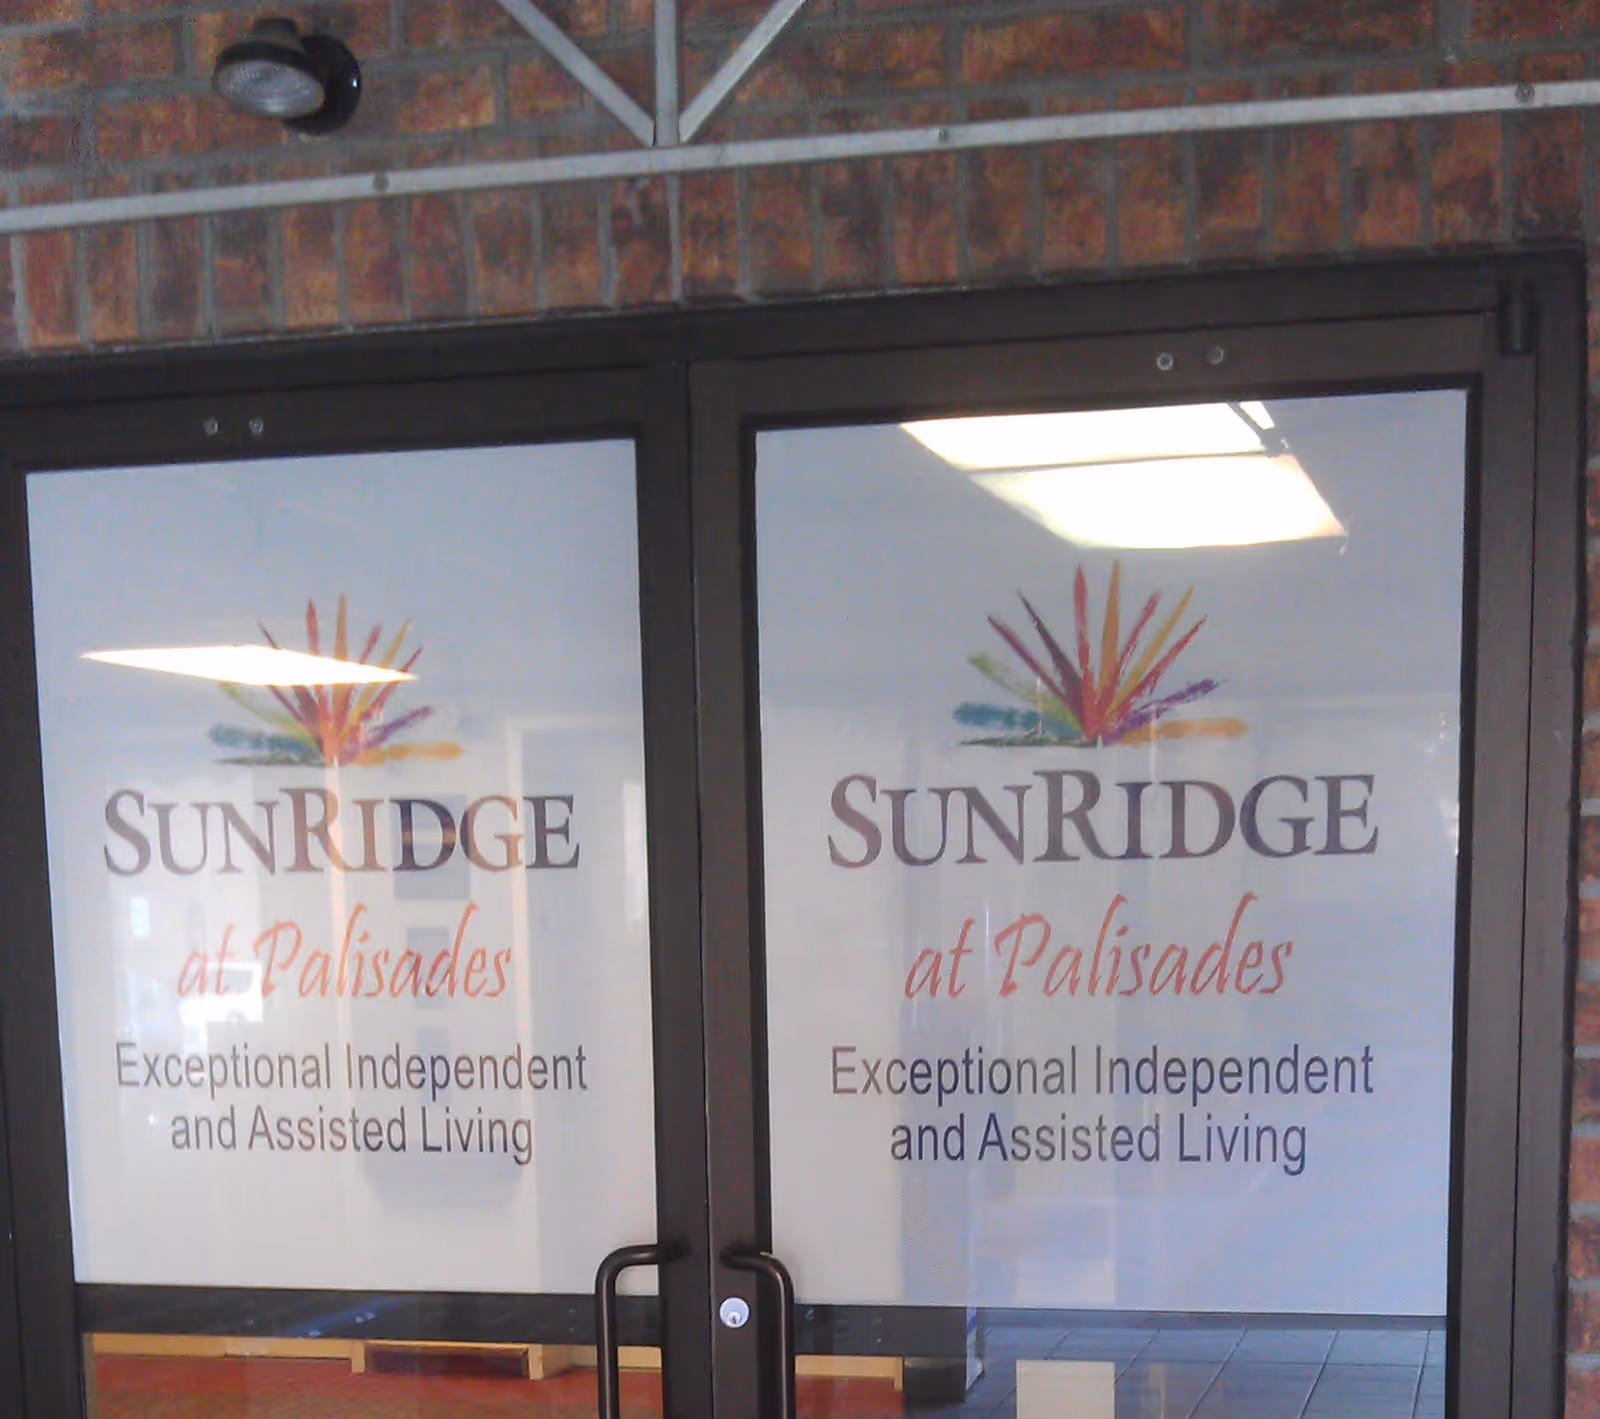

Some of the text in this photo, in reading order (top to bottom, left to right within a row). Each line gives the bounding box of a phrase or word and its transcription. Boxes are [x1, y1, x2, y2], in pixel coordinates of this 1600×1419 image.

[177, 902, 512, 999] at Palisades
[904, 892, 1294, 999] at Palisades
[115, 1042, 588, 1101] Exceptional Independent
[831, 1044, 1375, 1107] Exceptional Independent
[170, 1106, 533, 1166] and Assisted Living
[890, 1112, 1307, 1176] and Assisted Living
